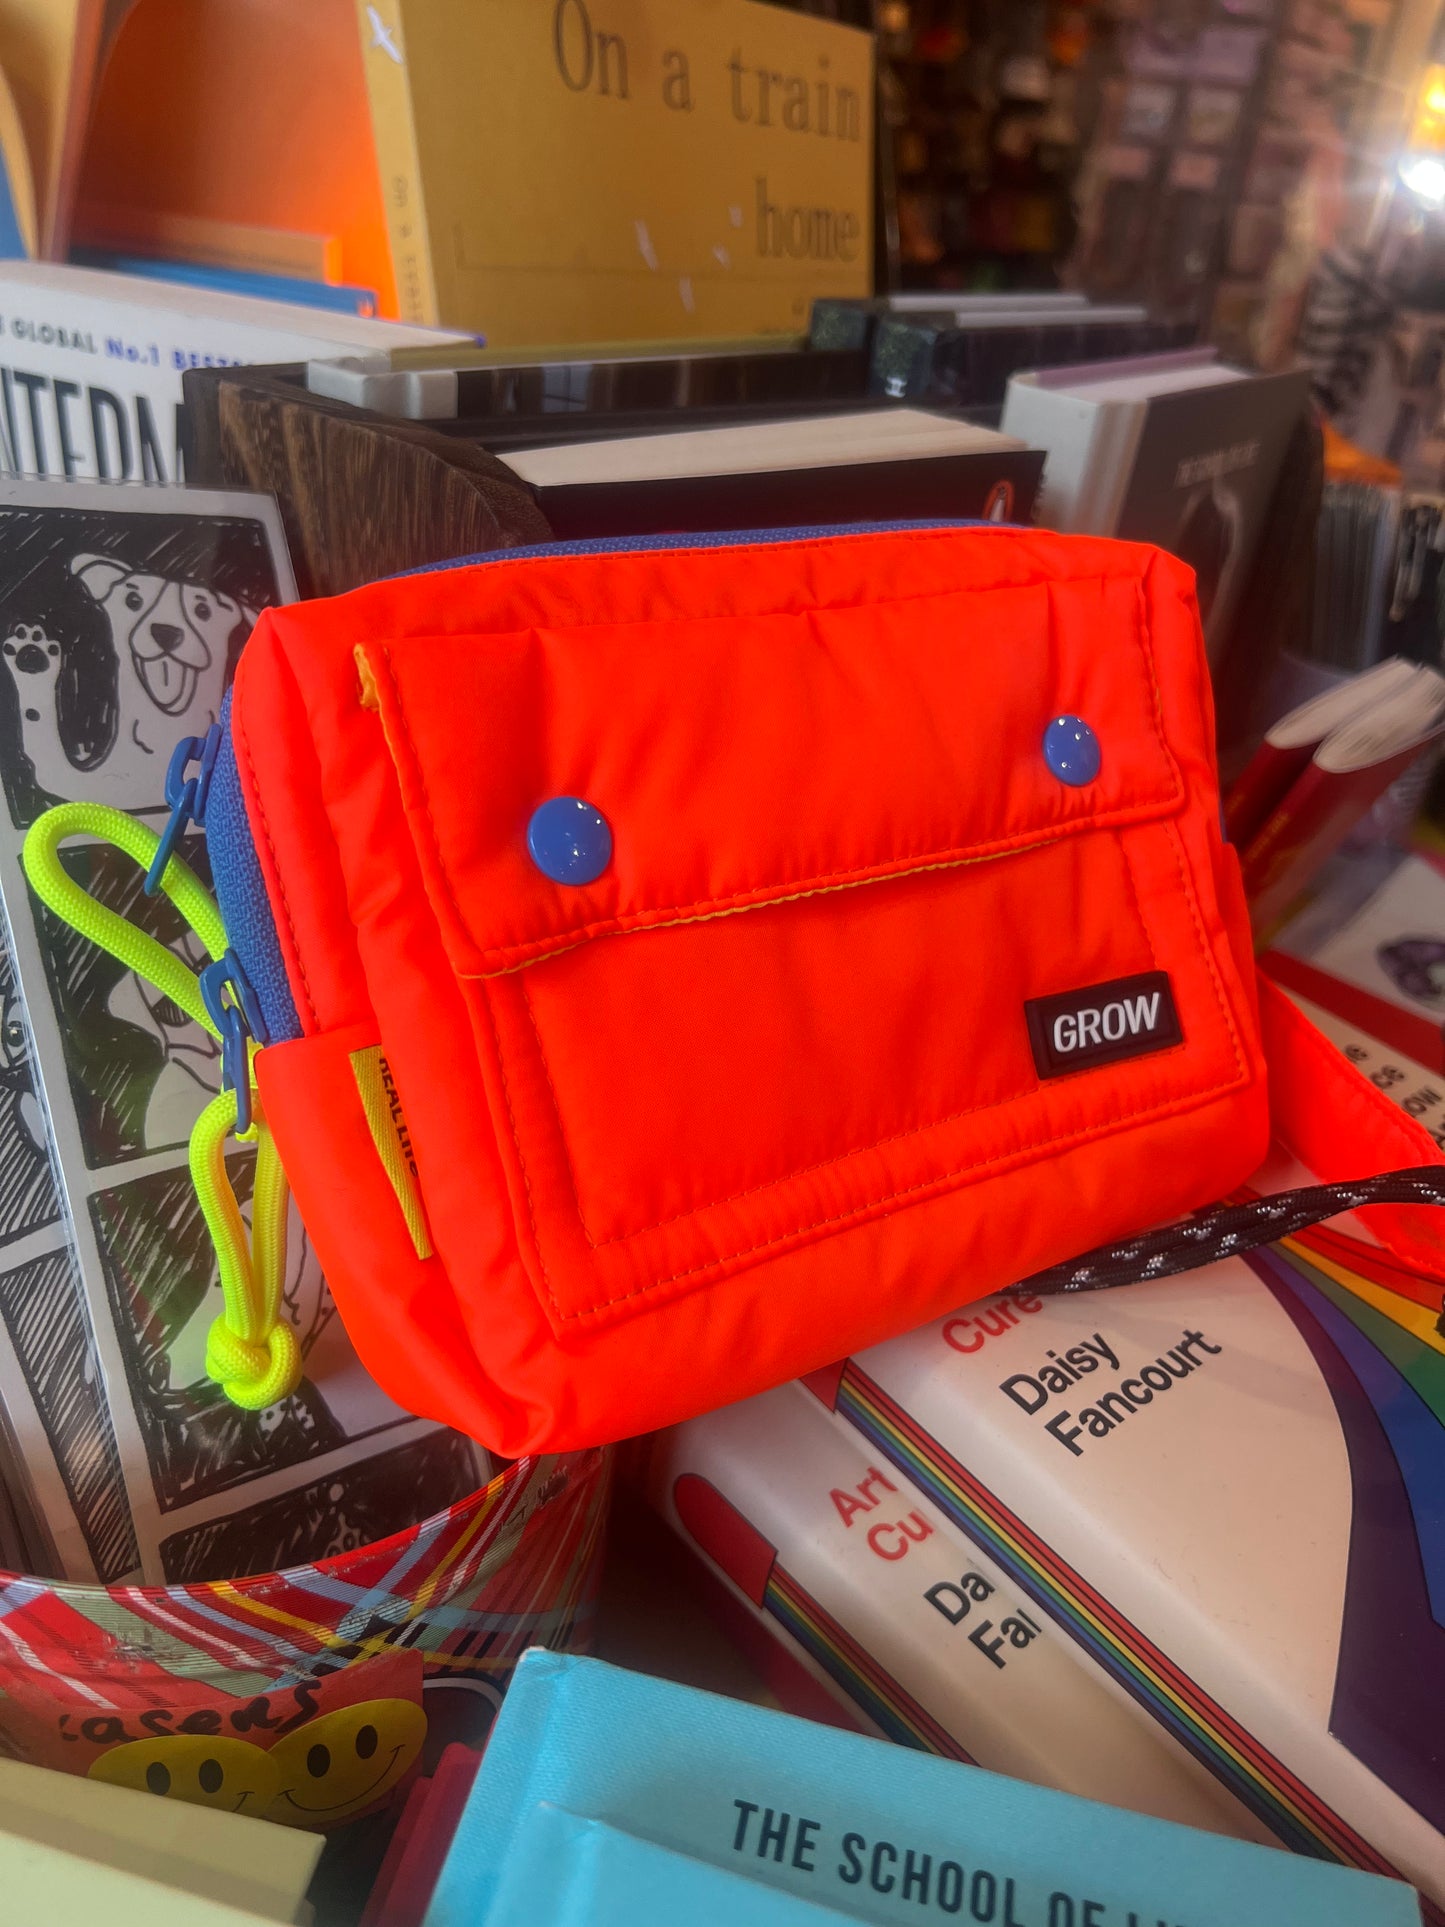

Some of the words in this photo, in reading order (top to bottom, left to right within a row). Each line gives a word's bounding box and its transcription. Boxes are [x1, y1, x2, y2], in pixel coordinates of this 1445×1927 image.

[554, 0, 630, 99] On
[661, 49, 693, 113] a
[727, 48, 860, 142] train
[755, 177, 860, 262] home
[11, 317, 97, 354] GLOBAL
[105, 336, 160, 367] No.1
[1053, 991, 1160, 1053] GROW
[941, 1295, 1044, 1355] Cure
[998, 1332, 1120, 1416] Daisy
[1043, 1329, 1223, 1457] Fancourt
[828, 1466, 898, 1529] Art
[866, 1510, 935, 1562] Cu
[923, 1571, 996, 1627] Da
[733, 1799, 821, 1872] THE
[837, 1832, 1025, 1927] SCHOOL
[1048, 1891, 1107, 1927] OF
